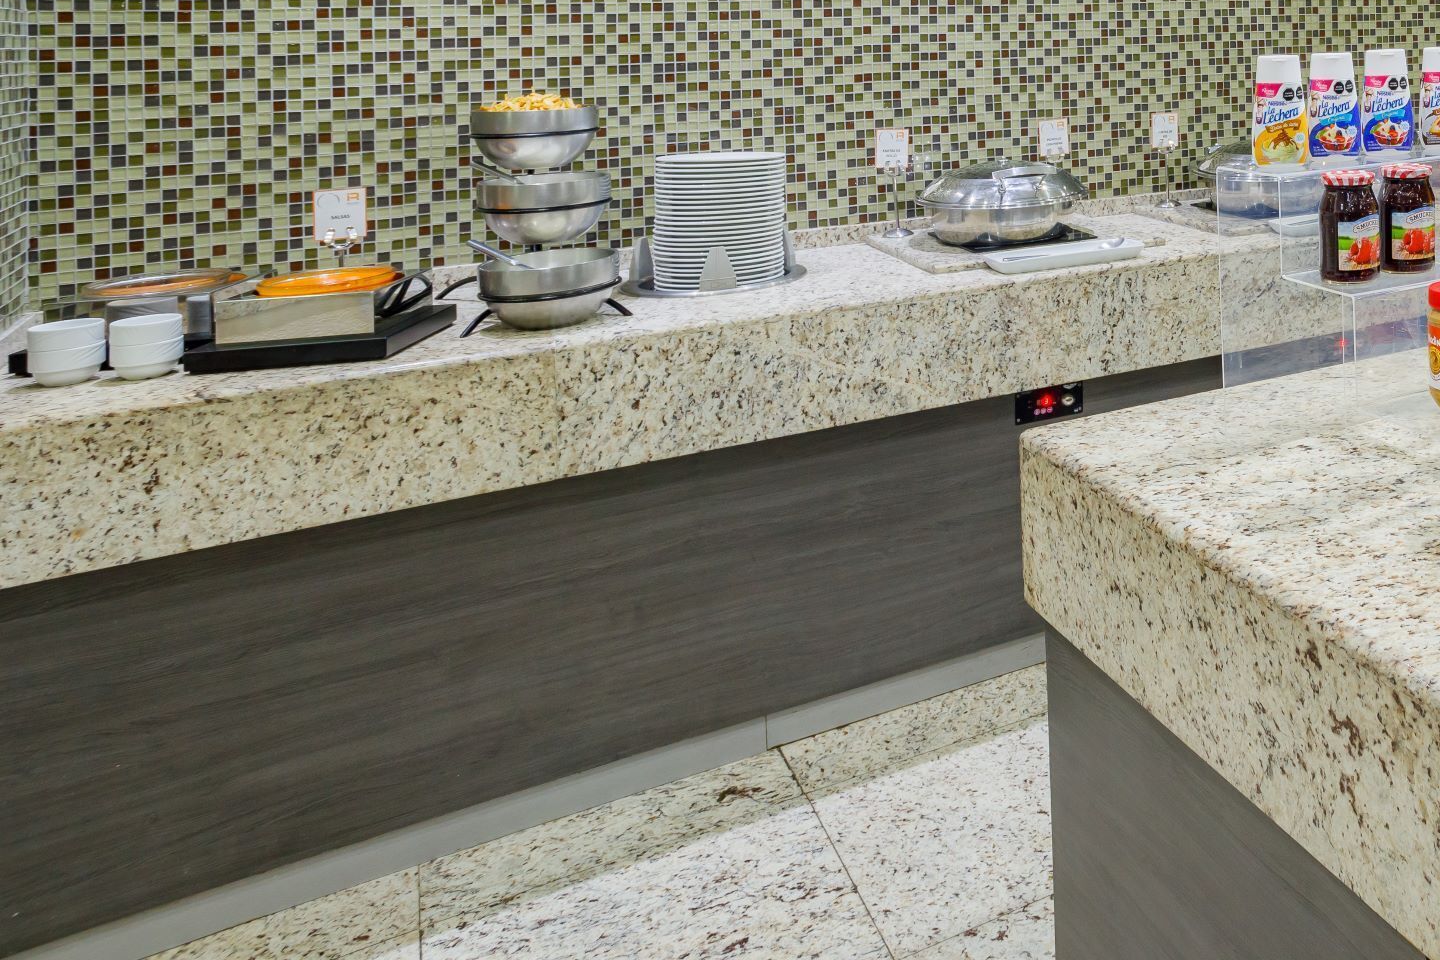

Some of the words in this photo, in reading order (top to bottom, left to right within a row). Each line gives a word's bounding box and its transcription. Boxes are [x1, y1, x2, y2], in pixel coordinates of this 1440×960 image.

[1317, 101, 1350, 118] Lechera
[1371, 97, 1404, 113] Lechera
[1262, 106, 1299, 125] Lechera
